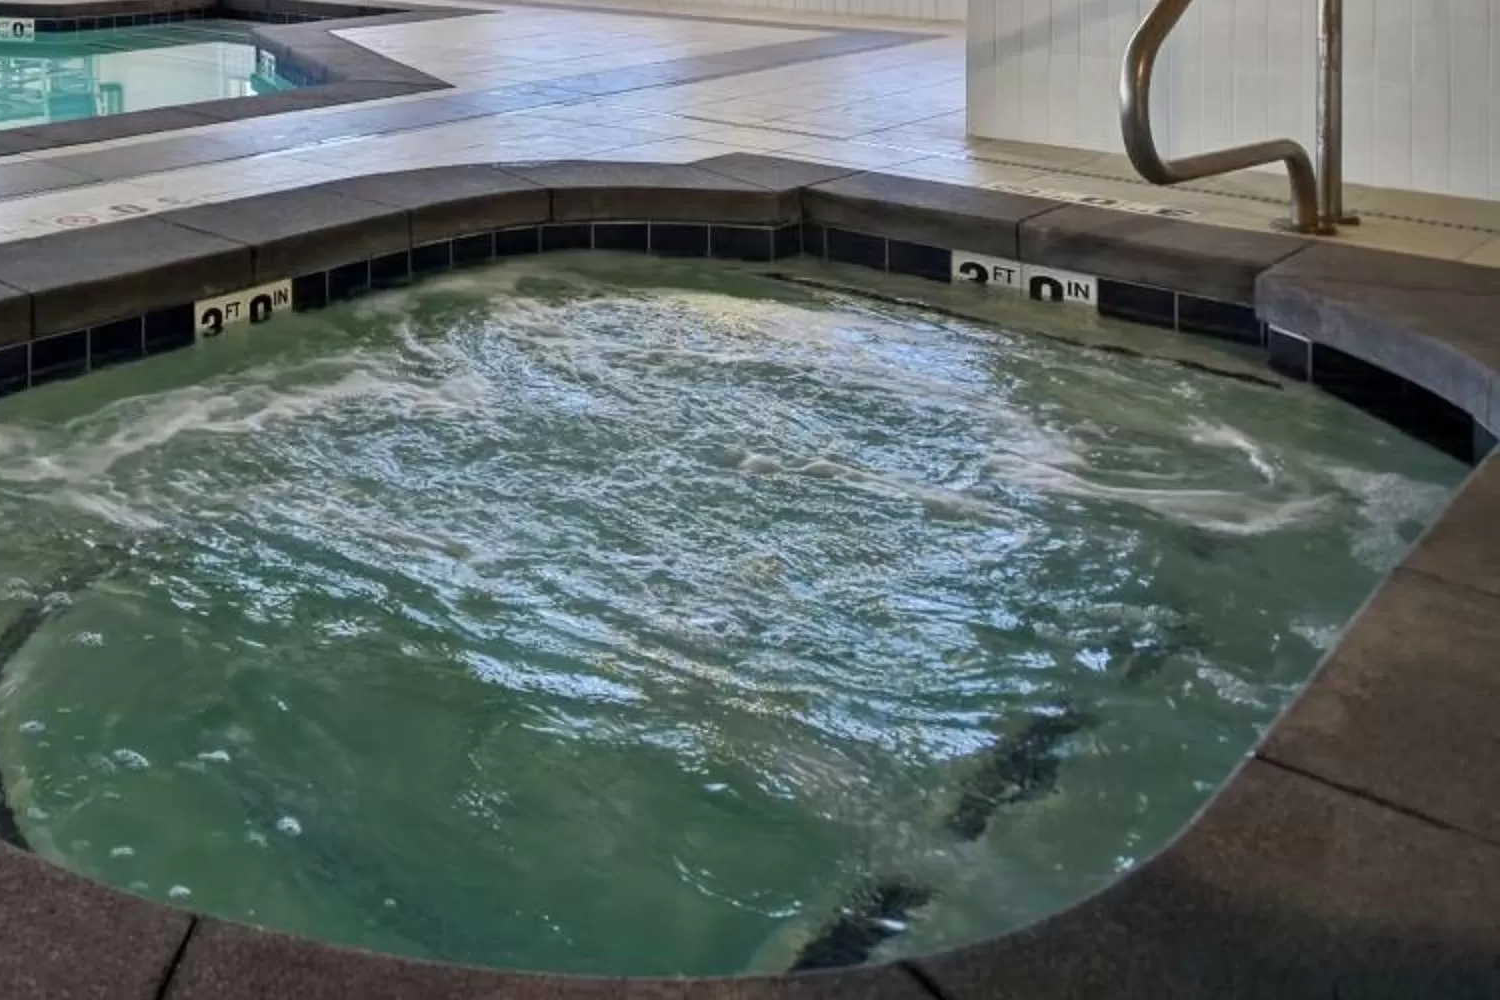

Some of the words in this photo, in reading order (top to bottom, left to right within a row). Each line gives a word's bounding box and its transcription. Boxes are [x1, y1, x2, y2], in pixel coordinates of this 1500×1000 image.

[992, 266, 1017, 285] FT
[1067, 279, 1090, 299] IN
[225, 301, 241, 320] FT
[273, 287, 288, 306] IN
